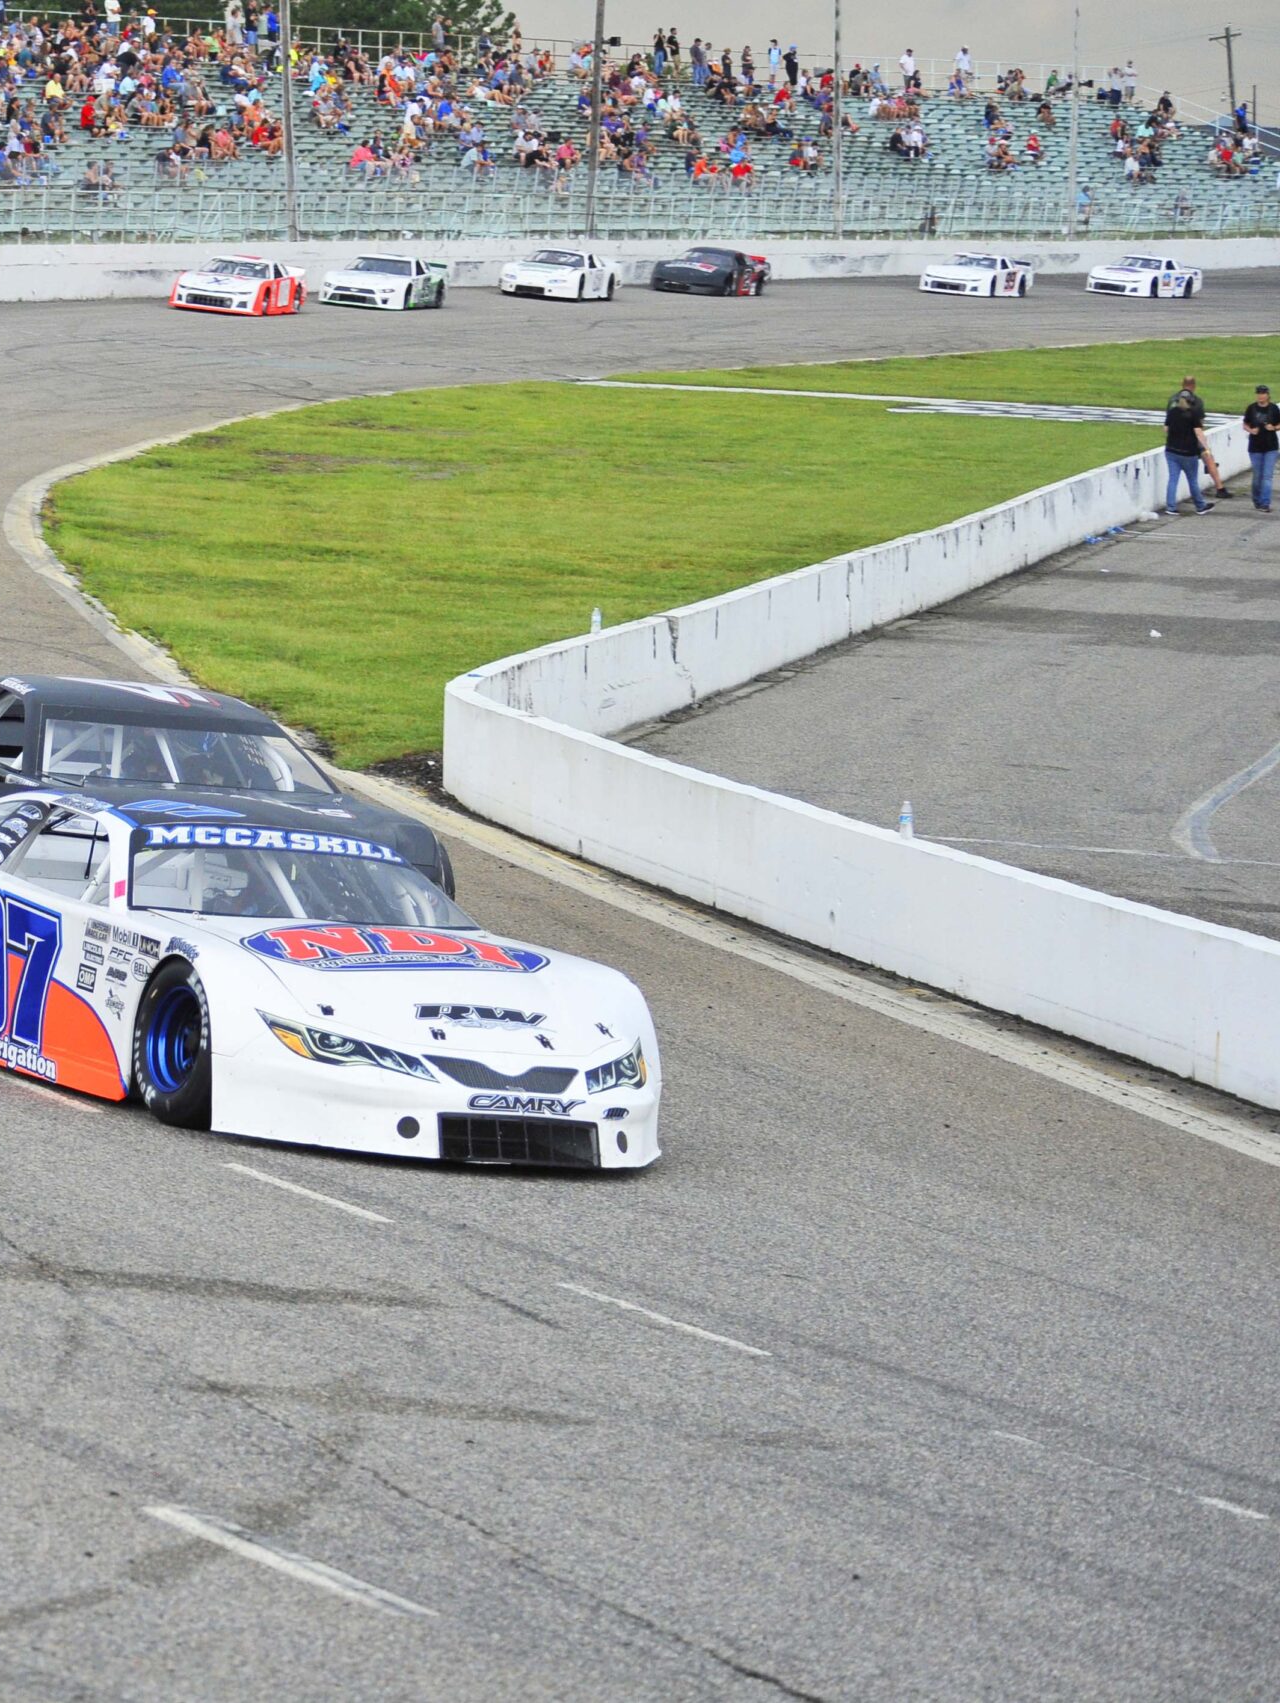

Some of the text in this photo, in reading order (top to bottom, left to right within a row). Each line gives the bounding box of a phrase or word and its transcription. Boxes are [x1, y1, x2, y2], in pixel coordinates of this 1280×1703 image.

[146, 822, 405, 863] MCCASKILL
[113, 925, 131, 945] Mobil
[109, 947, 134, 962] PFC
[268, 926, 524, 970] NDI
[79, 970, 95, 986] OMP
[133, 961, 151, 976] BELL
[415, 1003, 548, 1027] RW
[468, 1093, 587, 1117] CAMRY
